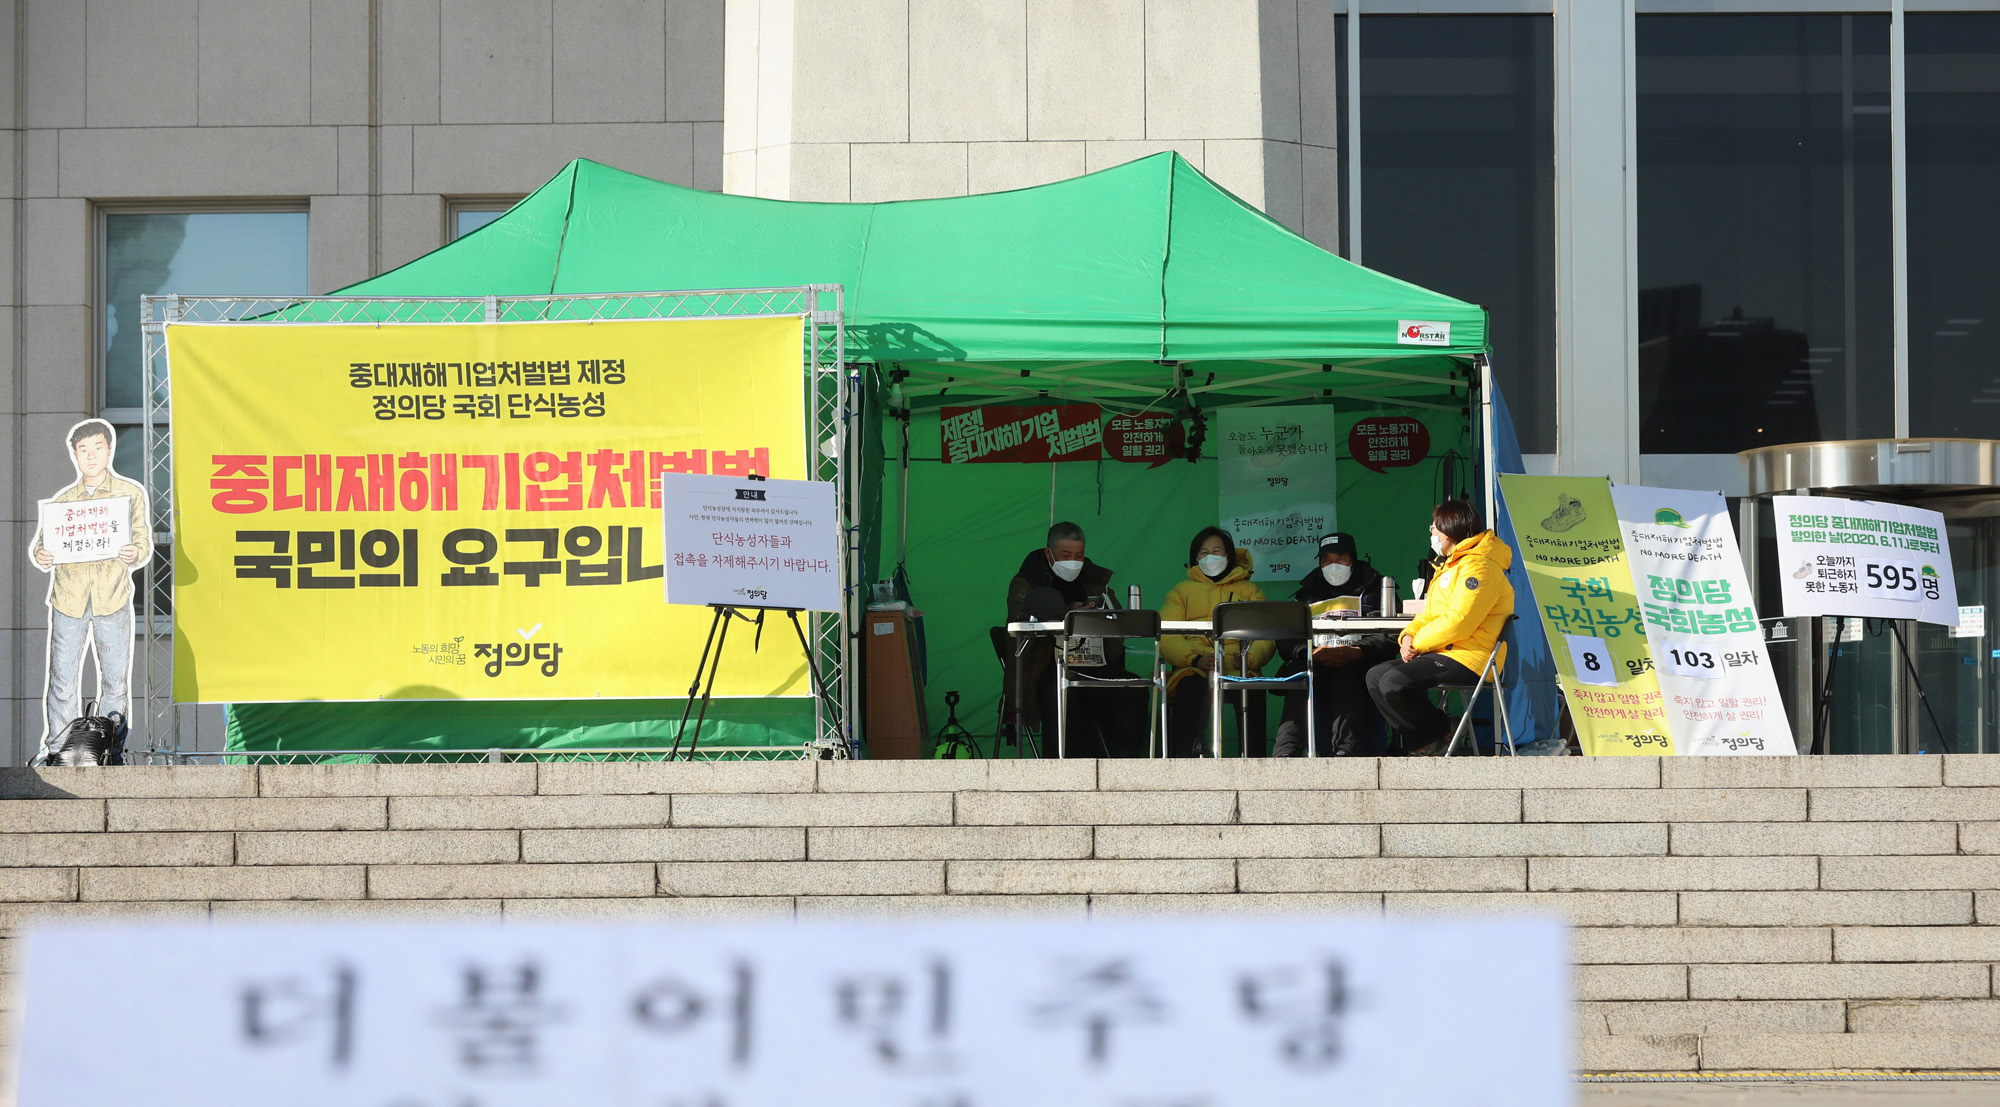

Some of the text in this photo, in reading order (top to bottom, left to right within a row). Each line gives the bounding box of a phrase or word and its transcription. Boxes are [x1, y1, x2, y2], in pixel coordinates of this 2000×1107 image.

[349, 359, 626, 388] 중대재해기업처벌법 제정
[372, 392, 606, 420] 정의당 국회 단식농성
[941, 408, 984, 442] 제정!
[1112, 419, 1132, 430] 모든
[1357, 423, 1419, 436] 모든 노동자가
[1047, 419, 1102, 459] 처벌법
[1123, 432, 1163, 443] 안전하게
[1228, 425, 1304, 441] 오늘도 누군가
[1276, 443, 1329, 457] 못했습니다
[1368, 437, 1409, 448] 안전하게
[1122, 445, 1165, 456] 일할 권리
[1368, 450, 1410, 462] 일할 권리
[1267, 477, 1289, 486] 정의당
[743, 491, 758, 499] 안내
[65, 505, 109, 521] 중대재해
[55, 520, 119, 537] 기업처벌법을
[1234, 516, 1324, 531] 중대재해기업처벌법
[1789, 514, 1939, 541] 정의당 중대재해기업처벌법
[712, 532, 792, 549] 단식농성자들과
[1239, 538, 1252, 547] NO
[1253, 537, 1284, 546] MORE
[1286, 535, 1320, 546] DEATH
[1525, 535, 1620, 551] 중대재해기업처벌법
[1631, 530, 1723, 551] 중대재해기업처벌법
[1791, 530, 1826, 543] 발의한
[63, 537, 110, 552] 제정하라!
[234, 528, 418, 589] 국민의
[674, 553, 831, 573] 접촉을 자제해주시기 바랍니다.
[1535, 554, 1620, 565] NO MORE DEATH
[1640, 549, 1722, 562] NO MORE DEATH
[1816, 555, 1855, 567] 오늘까지
[1269, 563, 1290, 573] 정의당
[1817, 568, 1857, 580] 퇴근하지
[1805, 581, 1858, 594] 못한 노동자
[1866, 563, 1940, 600] 595 명
[747, 589, 767, 600] 정의당
[1560, 577, 1615, 605] 국회
[1646, 574, 1731, 605] 정의당
[1643, 602, 1757, 635] 국회농성
[412, 643, 460, 654] 노동의 희망
[428, 654, 466, 665] 시민의 꿈
[474, 642, 563, 677] 정의당
[1582, 652, 1601, 671] 8
[1670, 649, 1759, 669] 103 일차
[1573, 689, 1594, 702] 죽지
[1594, 692, 1616, 703] 않고
[1618, 693, 1641, 705] 일할
[1674, 694, 1767, 709] 죽지 않고 일할 권리!
[1583, 705, 1627, 719] 안전하게
[1628, 709, 1640, 720] 살
[1683, 709, 1764, 721] 안전하게 살 권리!
[1625, 734, 1668, 748] 정의당
[1721, 737, 1764, 751] 정의당
